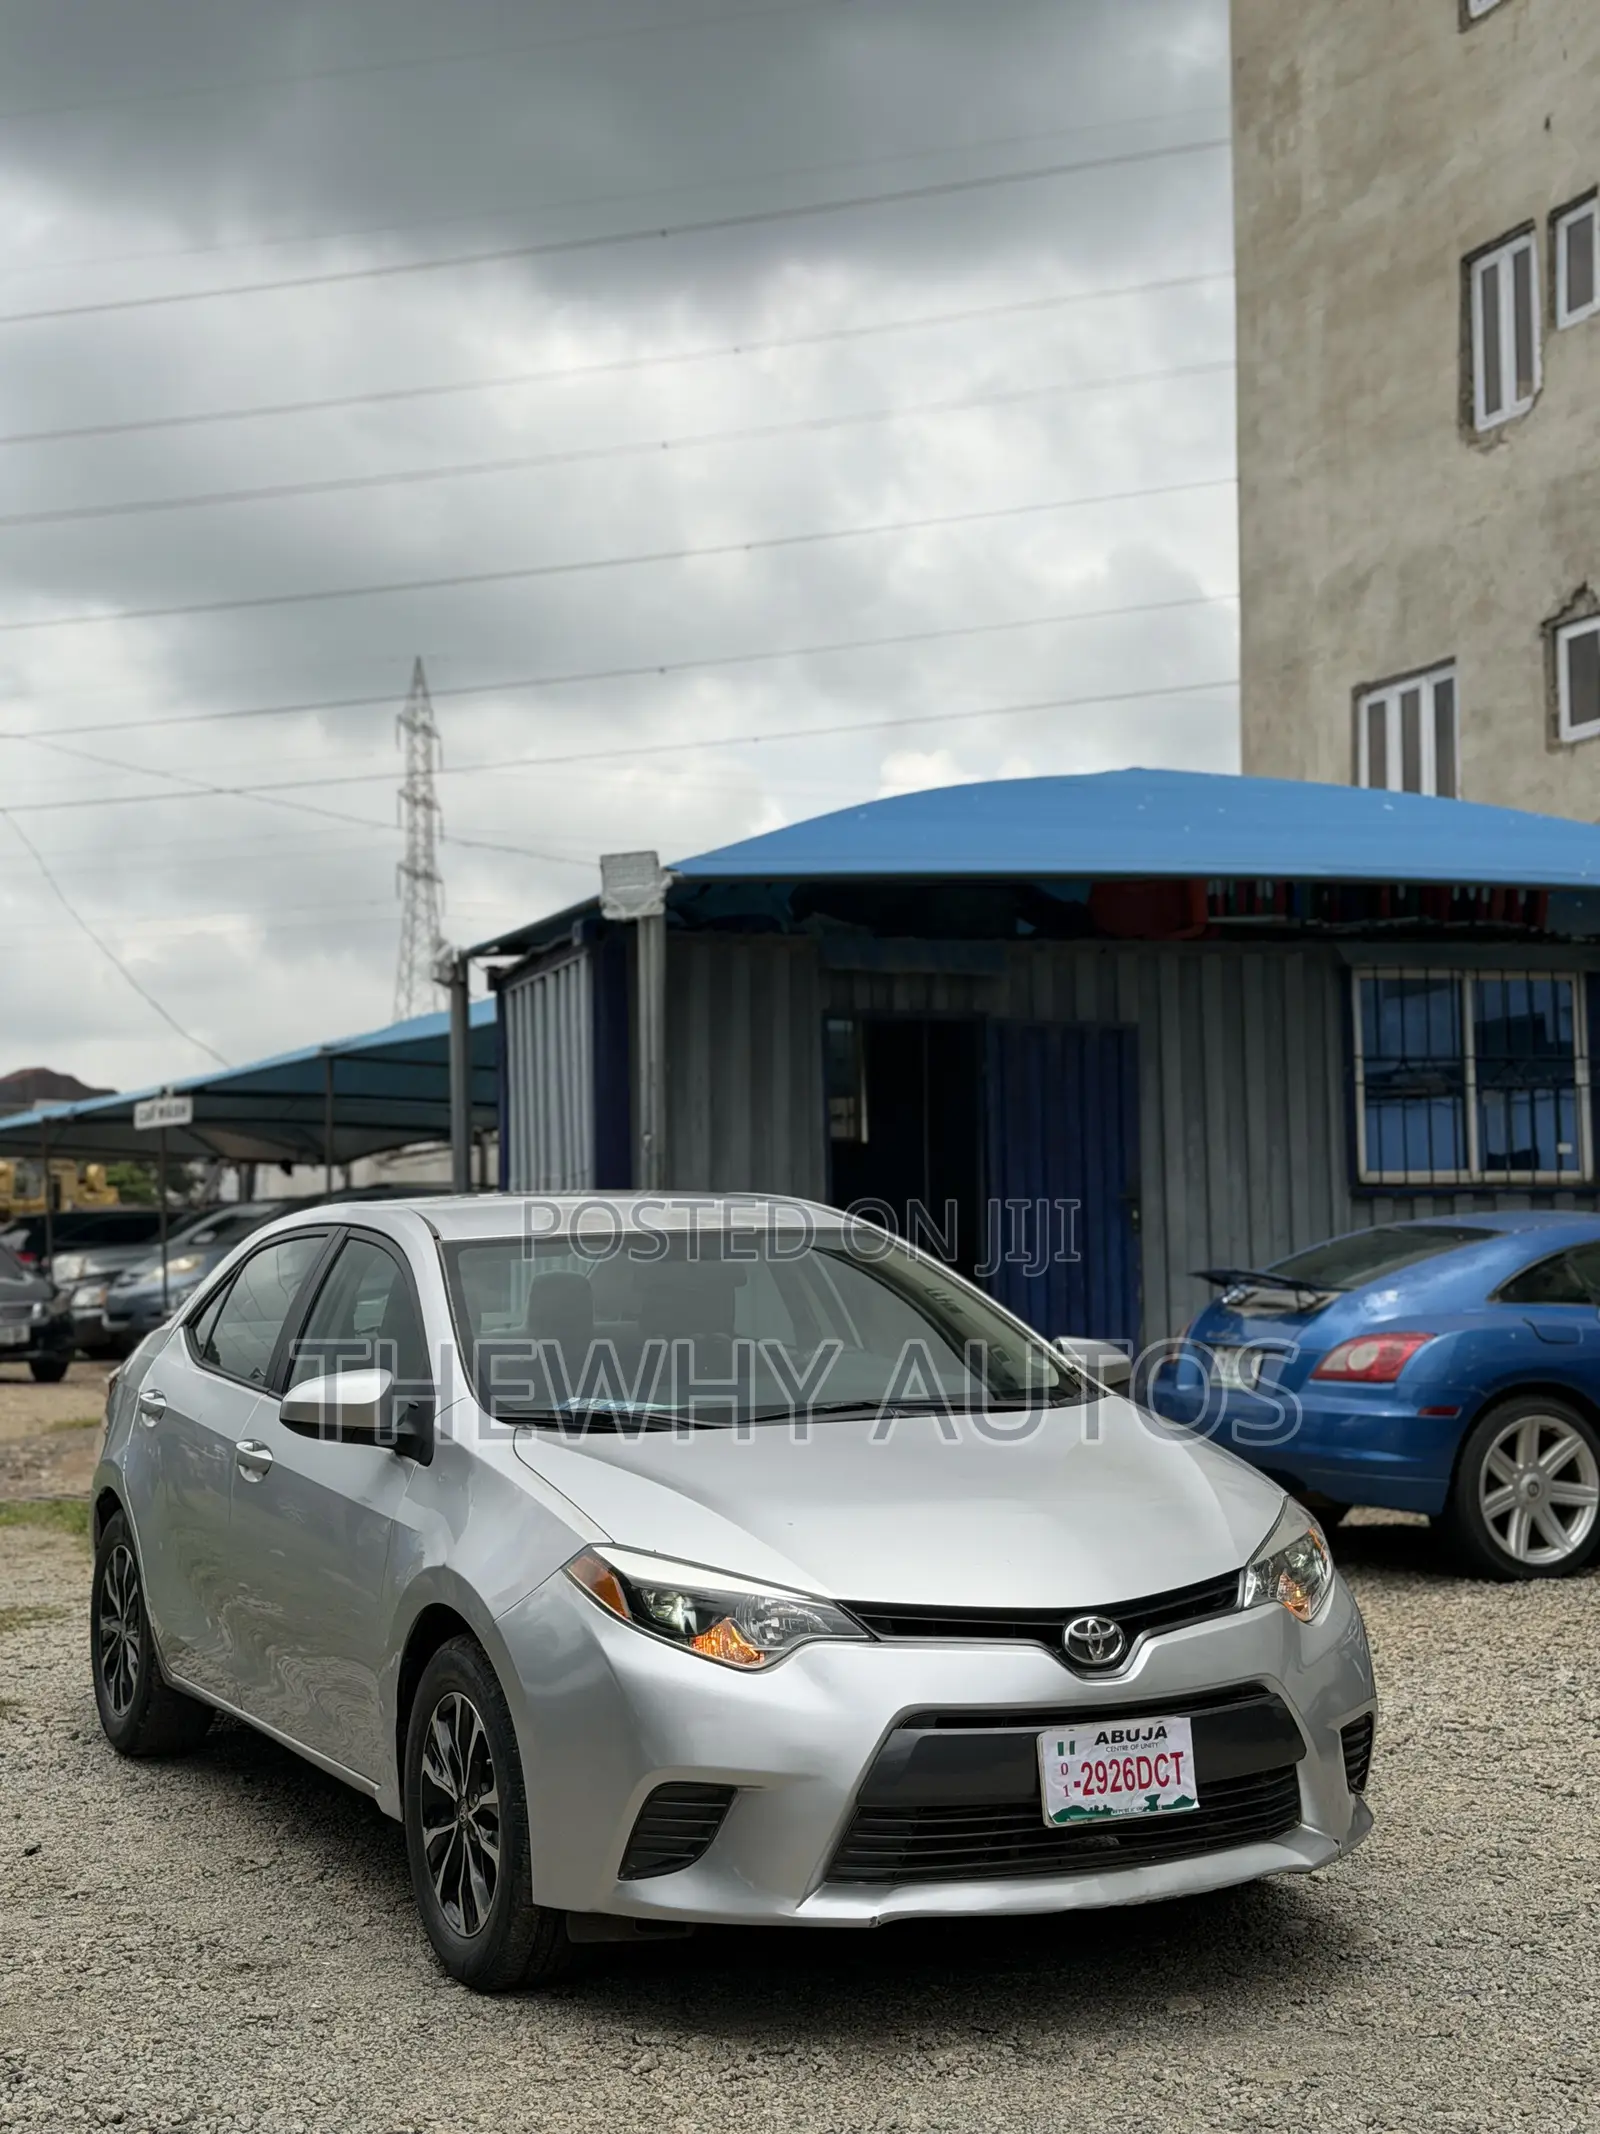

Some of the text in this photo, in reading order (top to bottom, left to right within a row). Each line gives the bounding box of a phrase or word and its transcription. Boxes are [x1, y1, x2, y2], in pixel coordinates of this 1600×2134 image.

[1095, 1726, 1168, 1745] ABUJA
[1105, 1741, 1159, 1753] CENTRE OF UNITY
